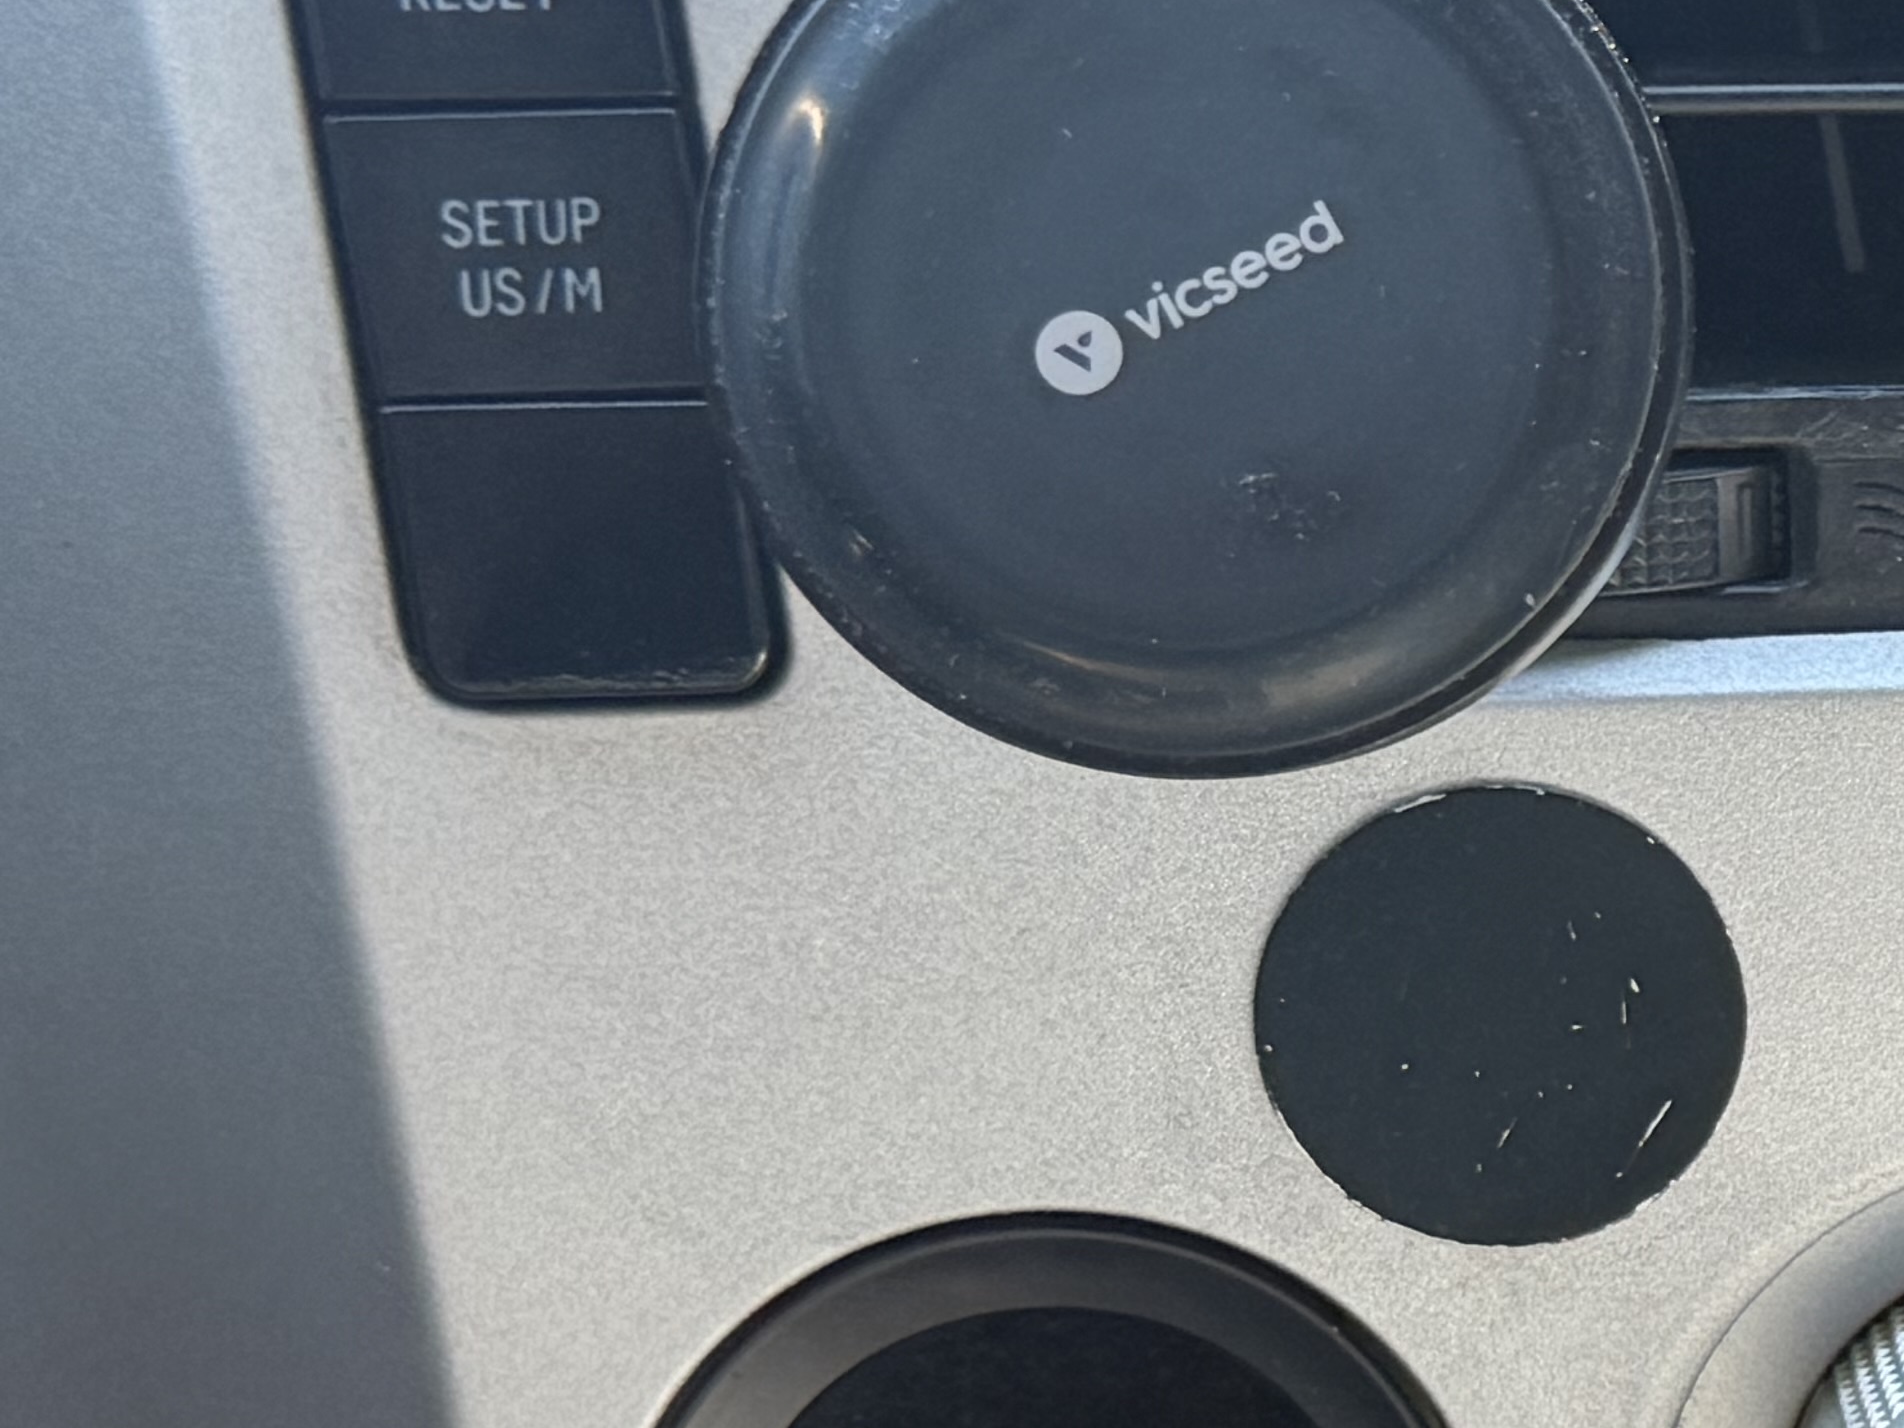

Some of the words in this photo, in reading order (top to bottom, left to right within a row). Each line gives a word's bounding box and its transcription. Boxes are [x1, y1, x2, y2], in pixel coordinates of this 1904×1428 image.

[441, 198, 600, 248] SETUP
[460, 267, 602, 317] US/M
[1124, 199, 1344, 339] vicseed
